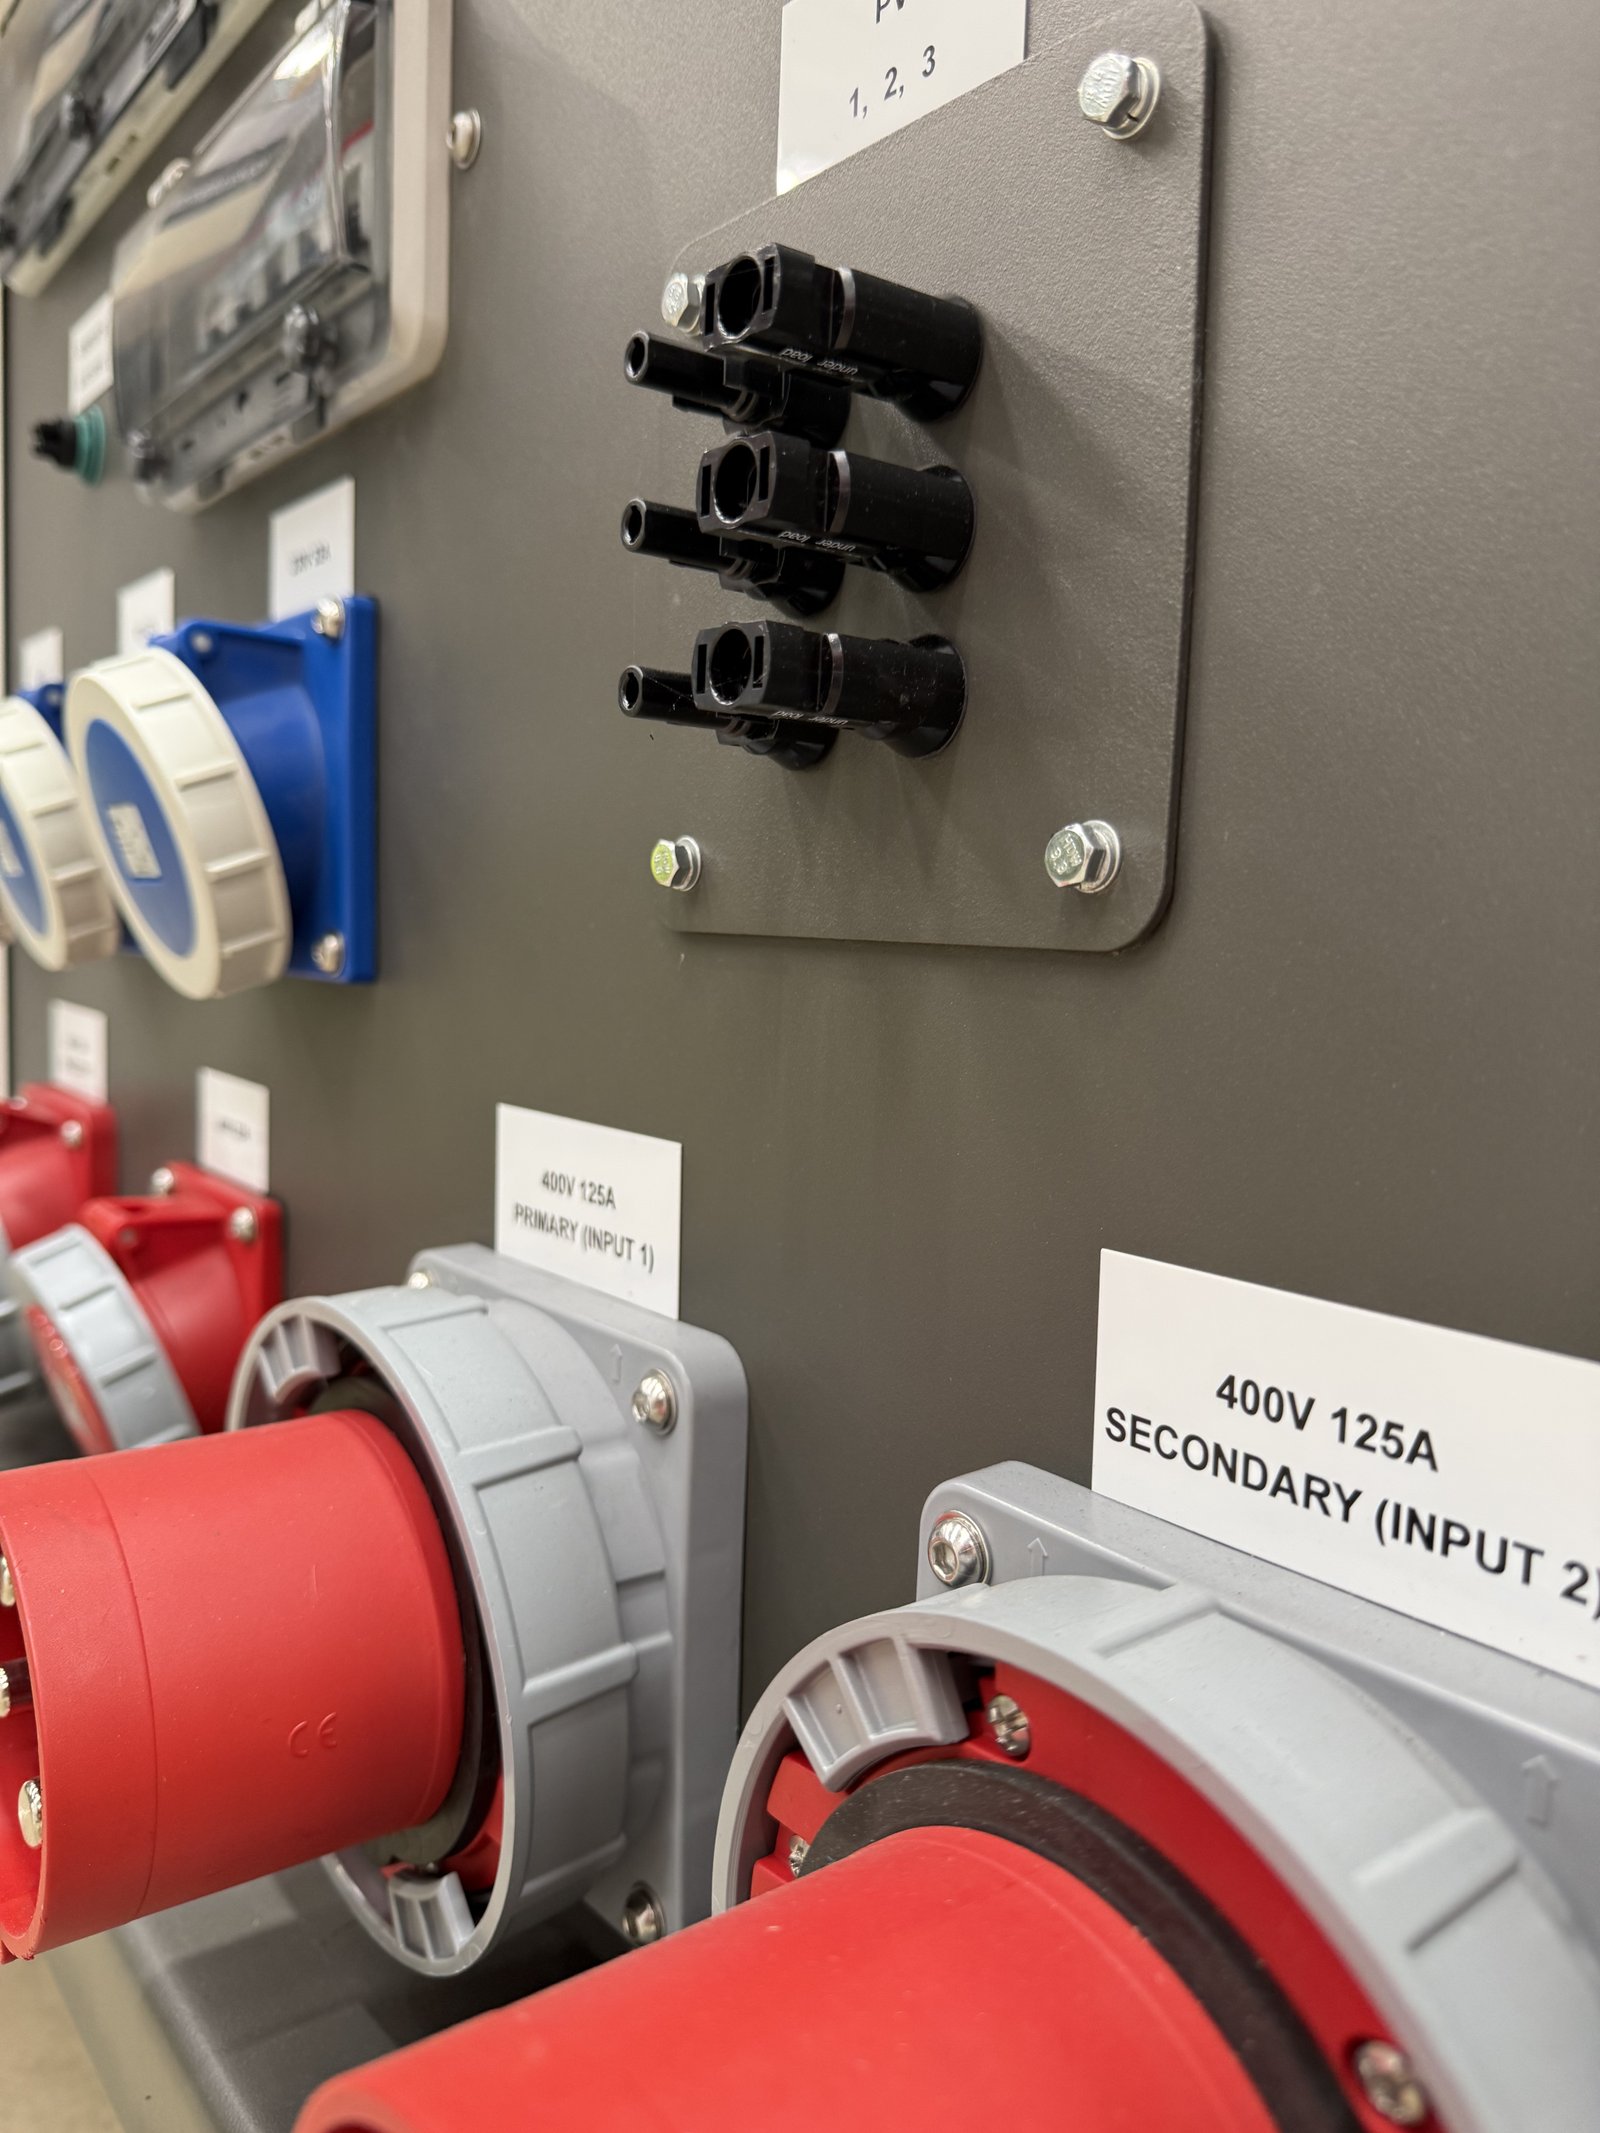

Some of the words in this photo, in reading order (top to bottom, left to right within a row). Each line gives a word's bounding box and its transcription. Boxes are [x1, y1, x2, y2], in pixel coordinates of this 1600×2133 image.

[849, 87, 868, 119] 1,
[884, 66, 904, 99] 2,
[922, 44, 936, 77] 3
[780, 348, 814, 363] load
[817, 360, 859, 375] under
[777, 530, 811, 543] load
[815, 540, 856, 552] under
[541, 1170, 576, 1197] 400V
[579, 1180, 617, 1209] 125A
[513, 1202, 579, 1242] PRIMARY
[581, 1225, 635, 1262] (INPUT
[641, 1243, 655, 1274] 1)
[1215, 1374, 1316, 1431] 400V
[1331, 1406, 1440, 1472] 125A
[1104, 1406, 1363, 1524] SECONDARY
[1374, 1497, 1546, 1587] (INPUT
